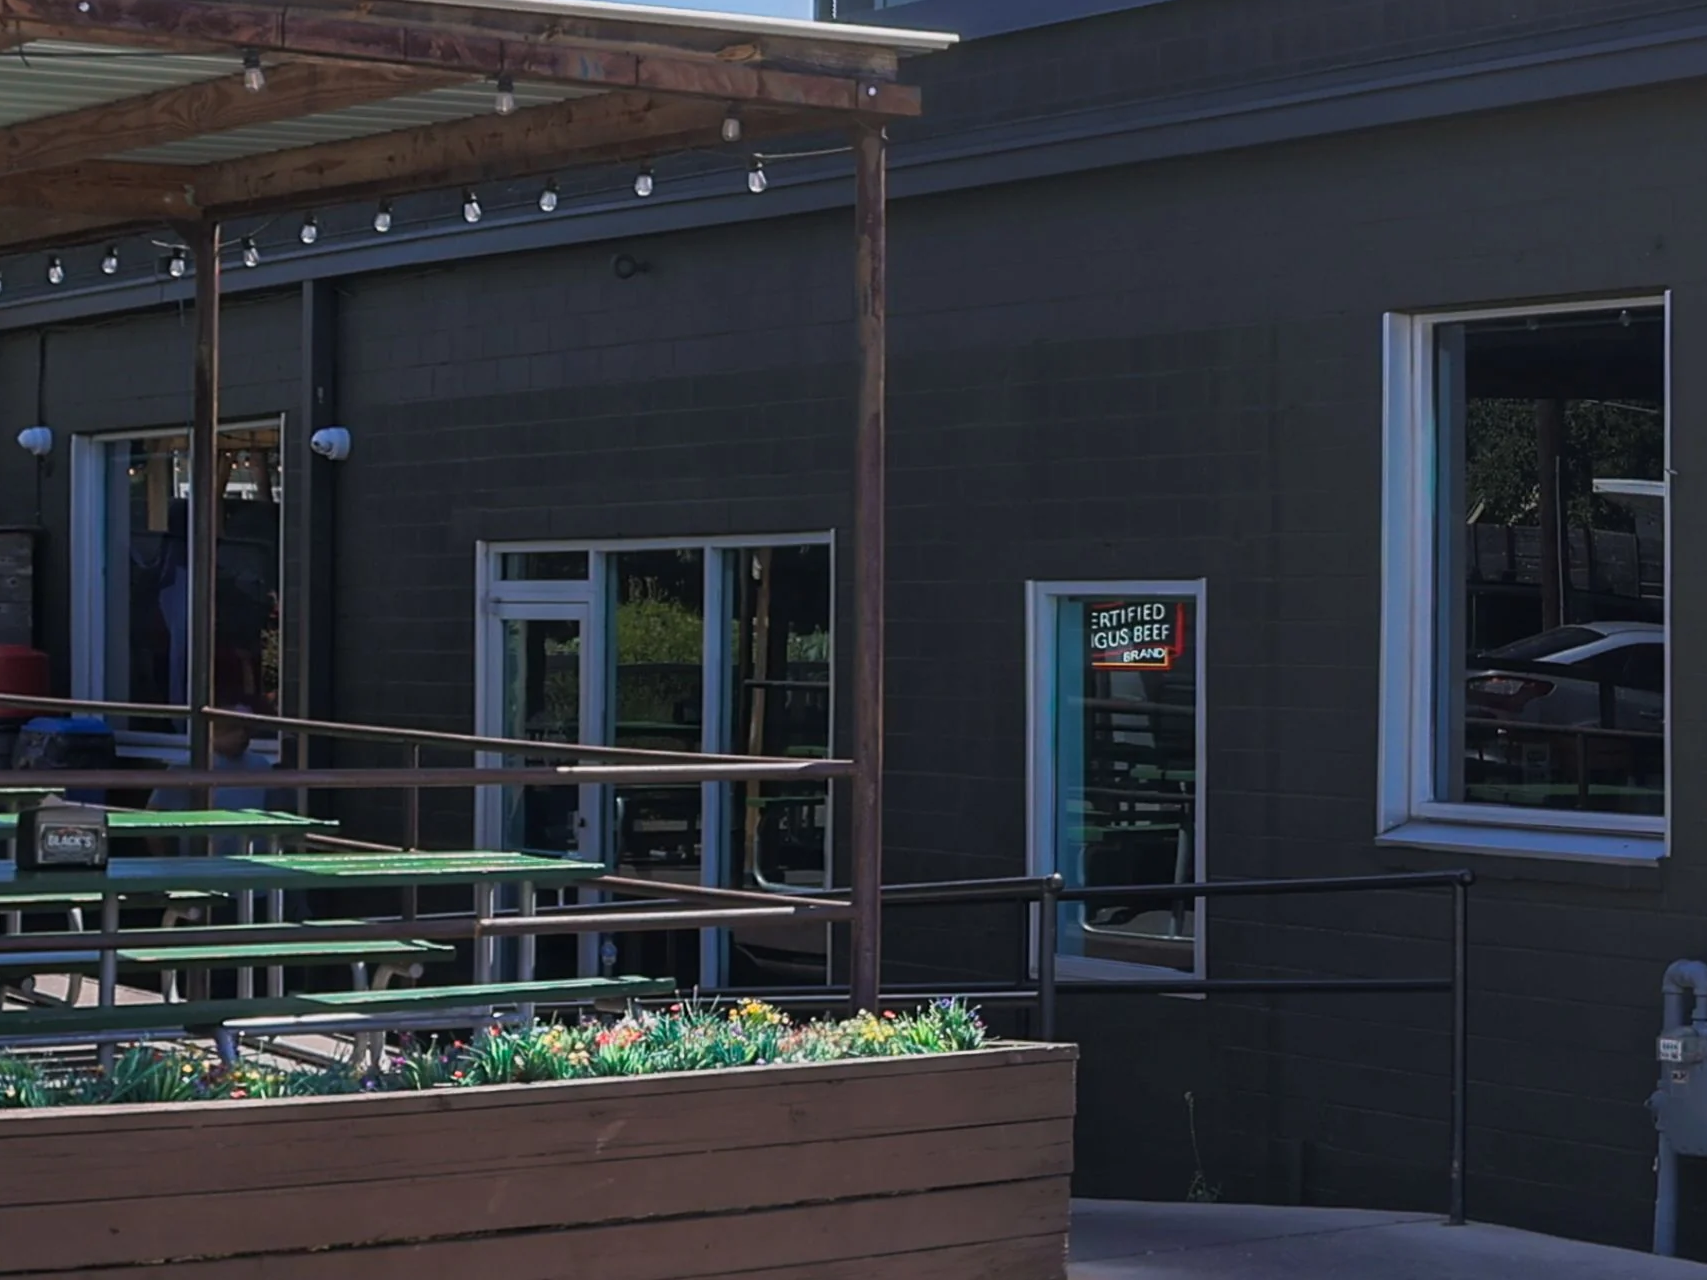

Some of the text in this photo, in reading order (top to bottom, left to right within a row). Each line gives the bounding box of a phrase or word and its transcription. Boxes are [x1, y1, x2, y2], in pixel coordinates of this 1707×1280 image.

[1091, 603, 1165, 629] ERTIFIED
[1091, 624, 1170, 649] GUS BEEF
[1123, 647, 1165, 662] BRAND
